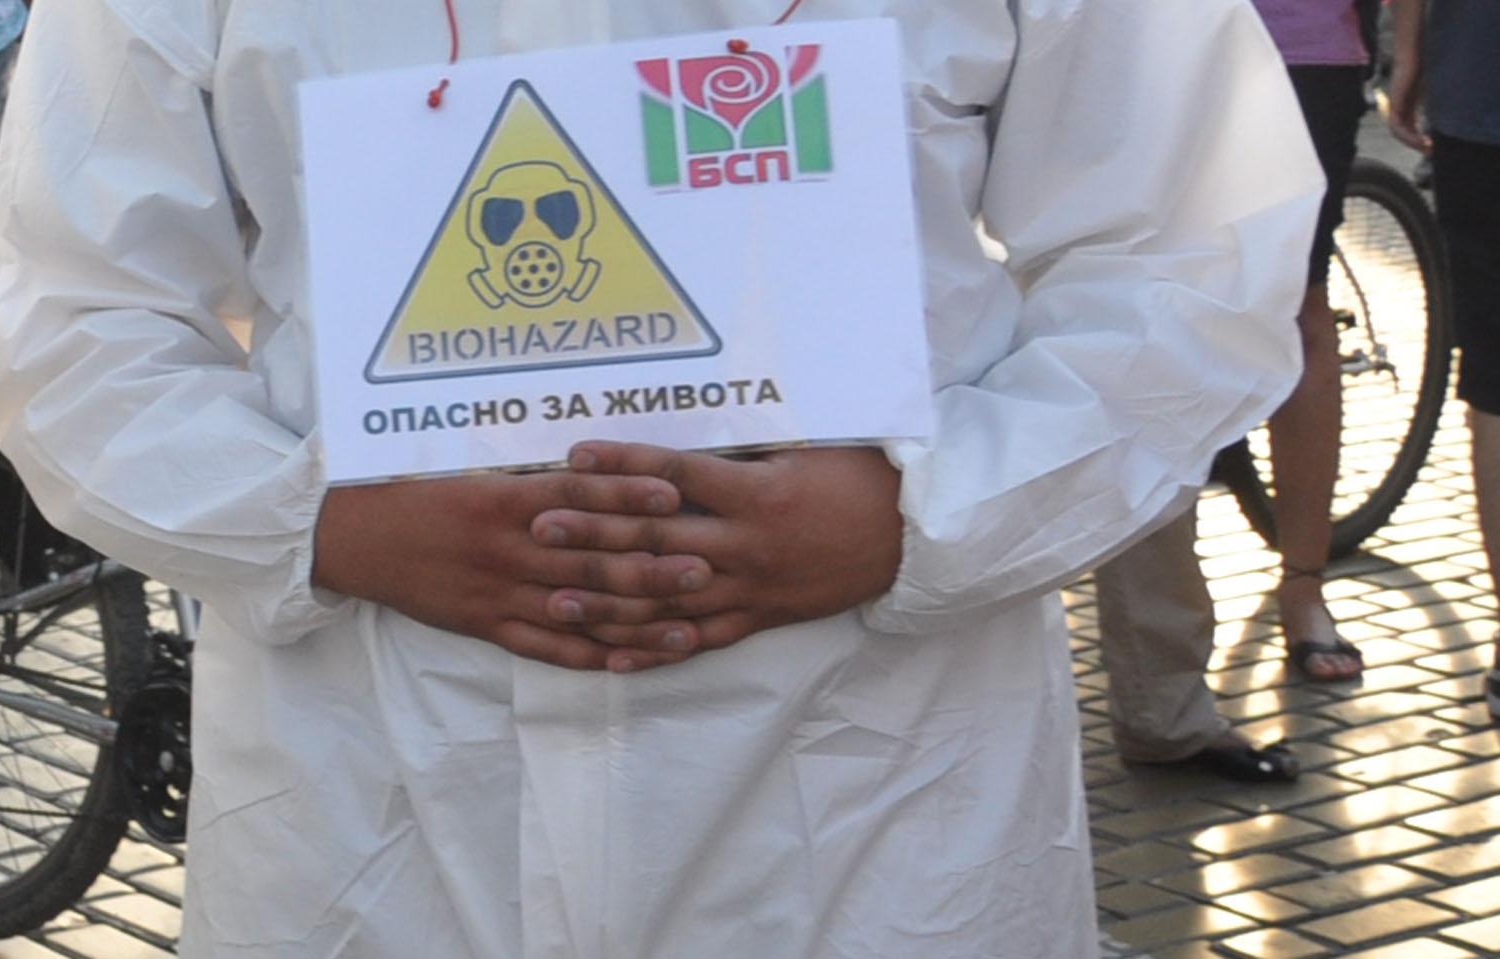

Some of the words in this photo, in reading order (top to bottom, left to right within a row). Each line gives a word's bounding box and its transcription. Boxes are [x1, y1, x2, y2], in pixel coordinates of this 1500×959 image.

[688, 149, 791, 189] БСП
[408, 311, 678, 364] BIOHAZARD
[363, 398, 528, 435] ОПАСНО
[542, 393, 593, 421] ЗА
[603, 379, 782, 416] ЖИВОТА
